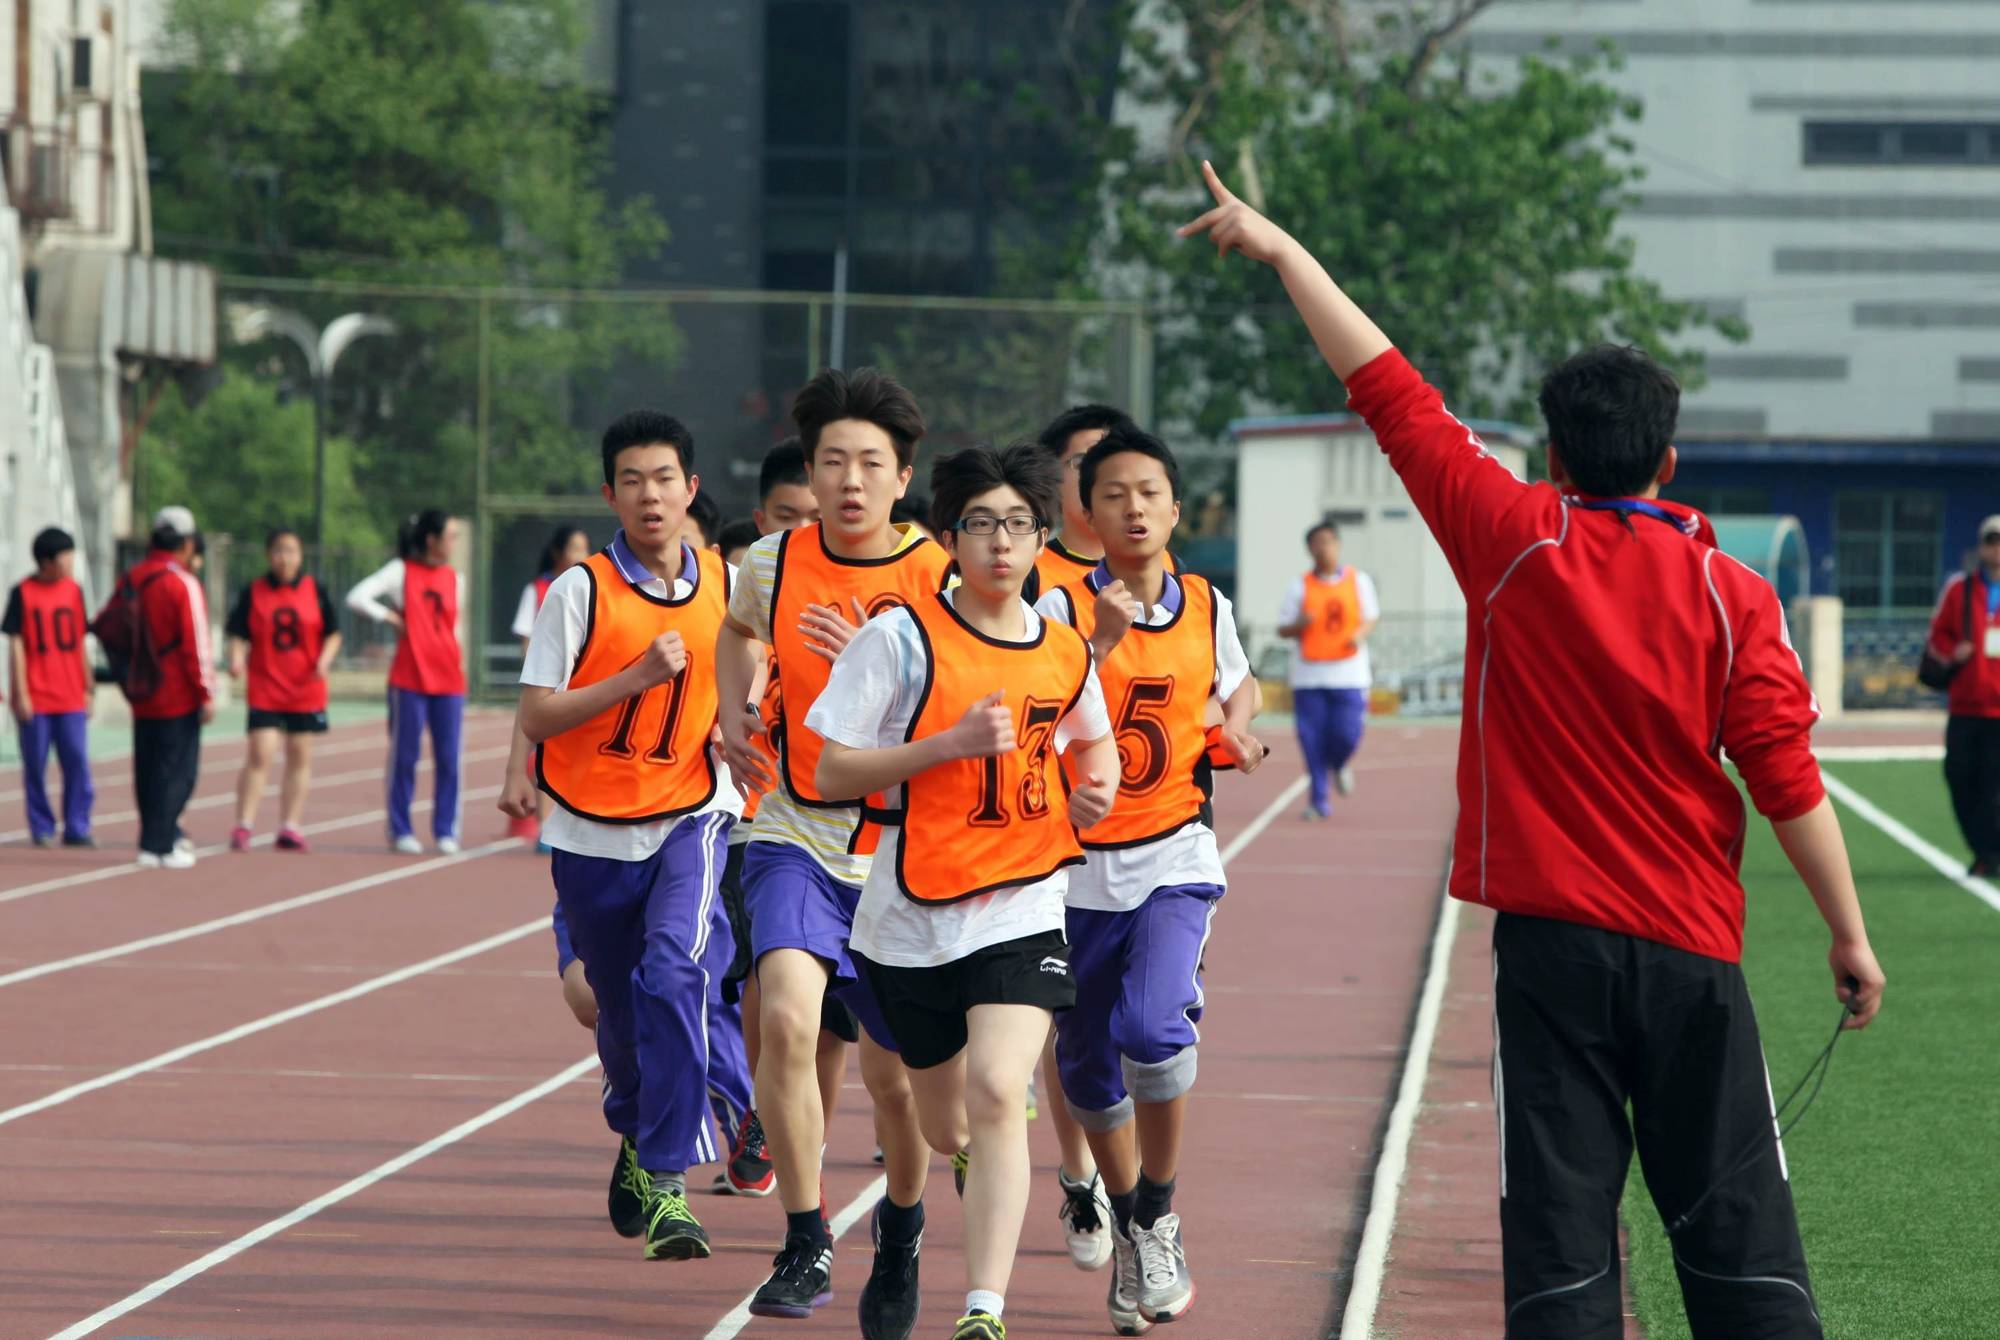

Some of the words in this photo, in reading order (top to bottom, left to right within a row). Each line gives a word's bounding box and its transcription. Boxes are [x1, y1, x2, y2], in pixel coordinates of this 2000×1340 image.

[33, 607, 78, 655] 10
[272, 608, 299, 652] 8
[598, 650, 692, 766] 11
[1112, 674, 1175, 799] 5
